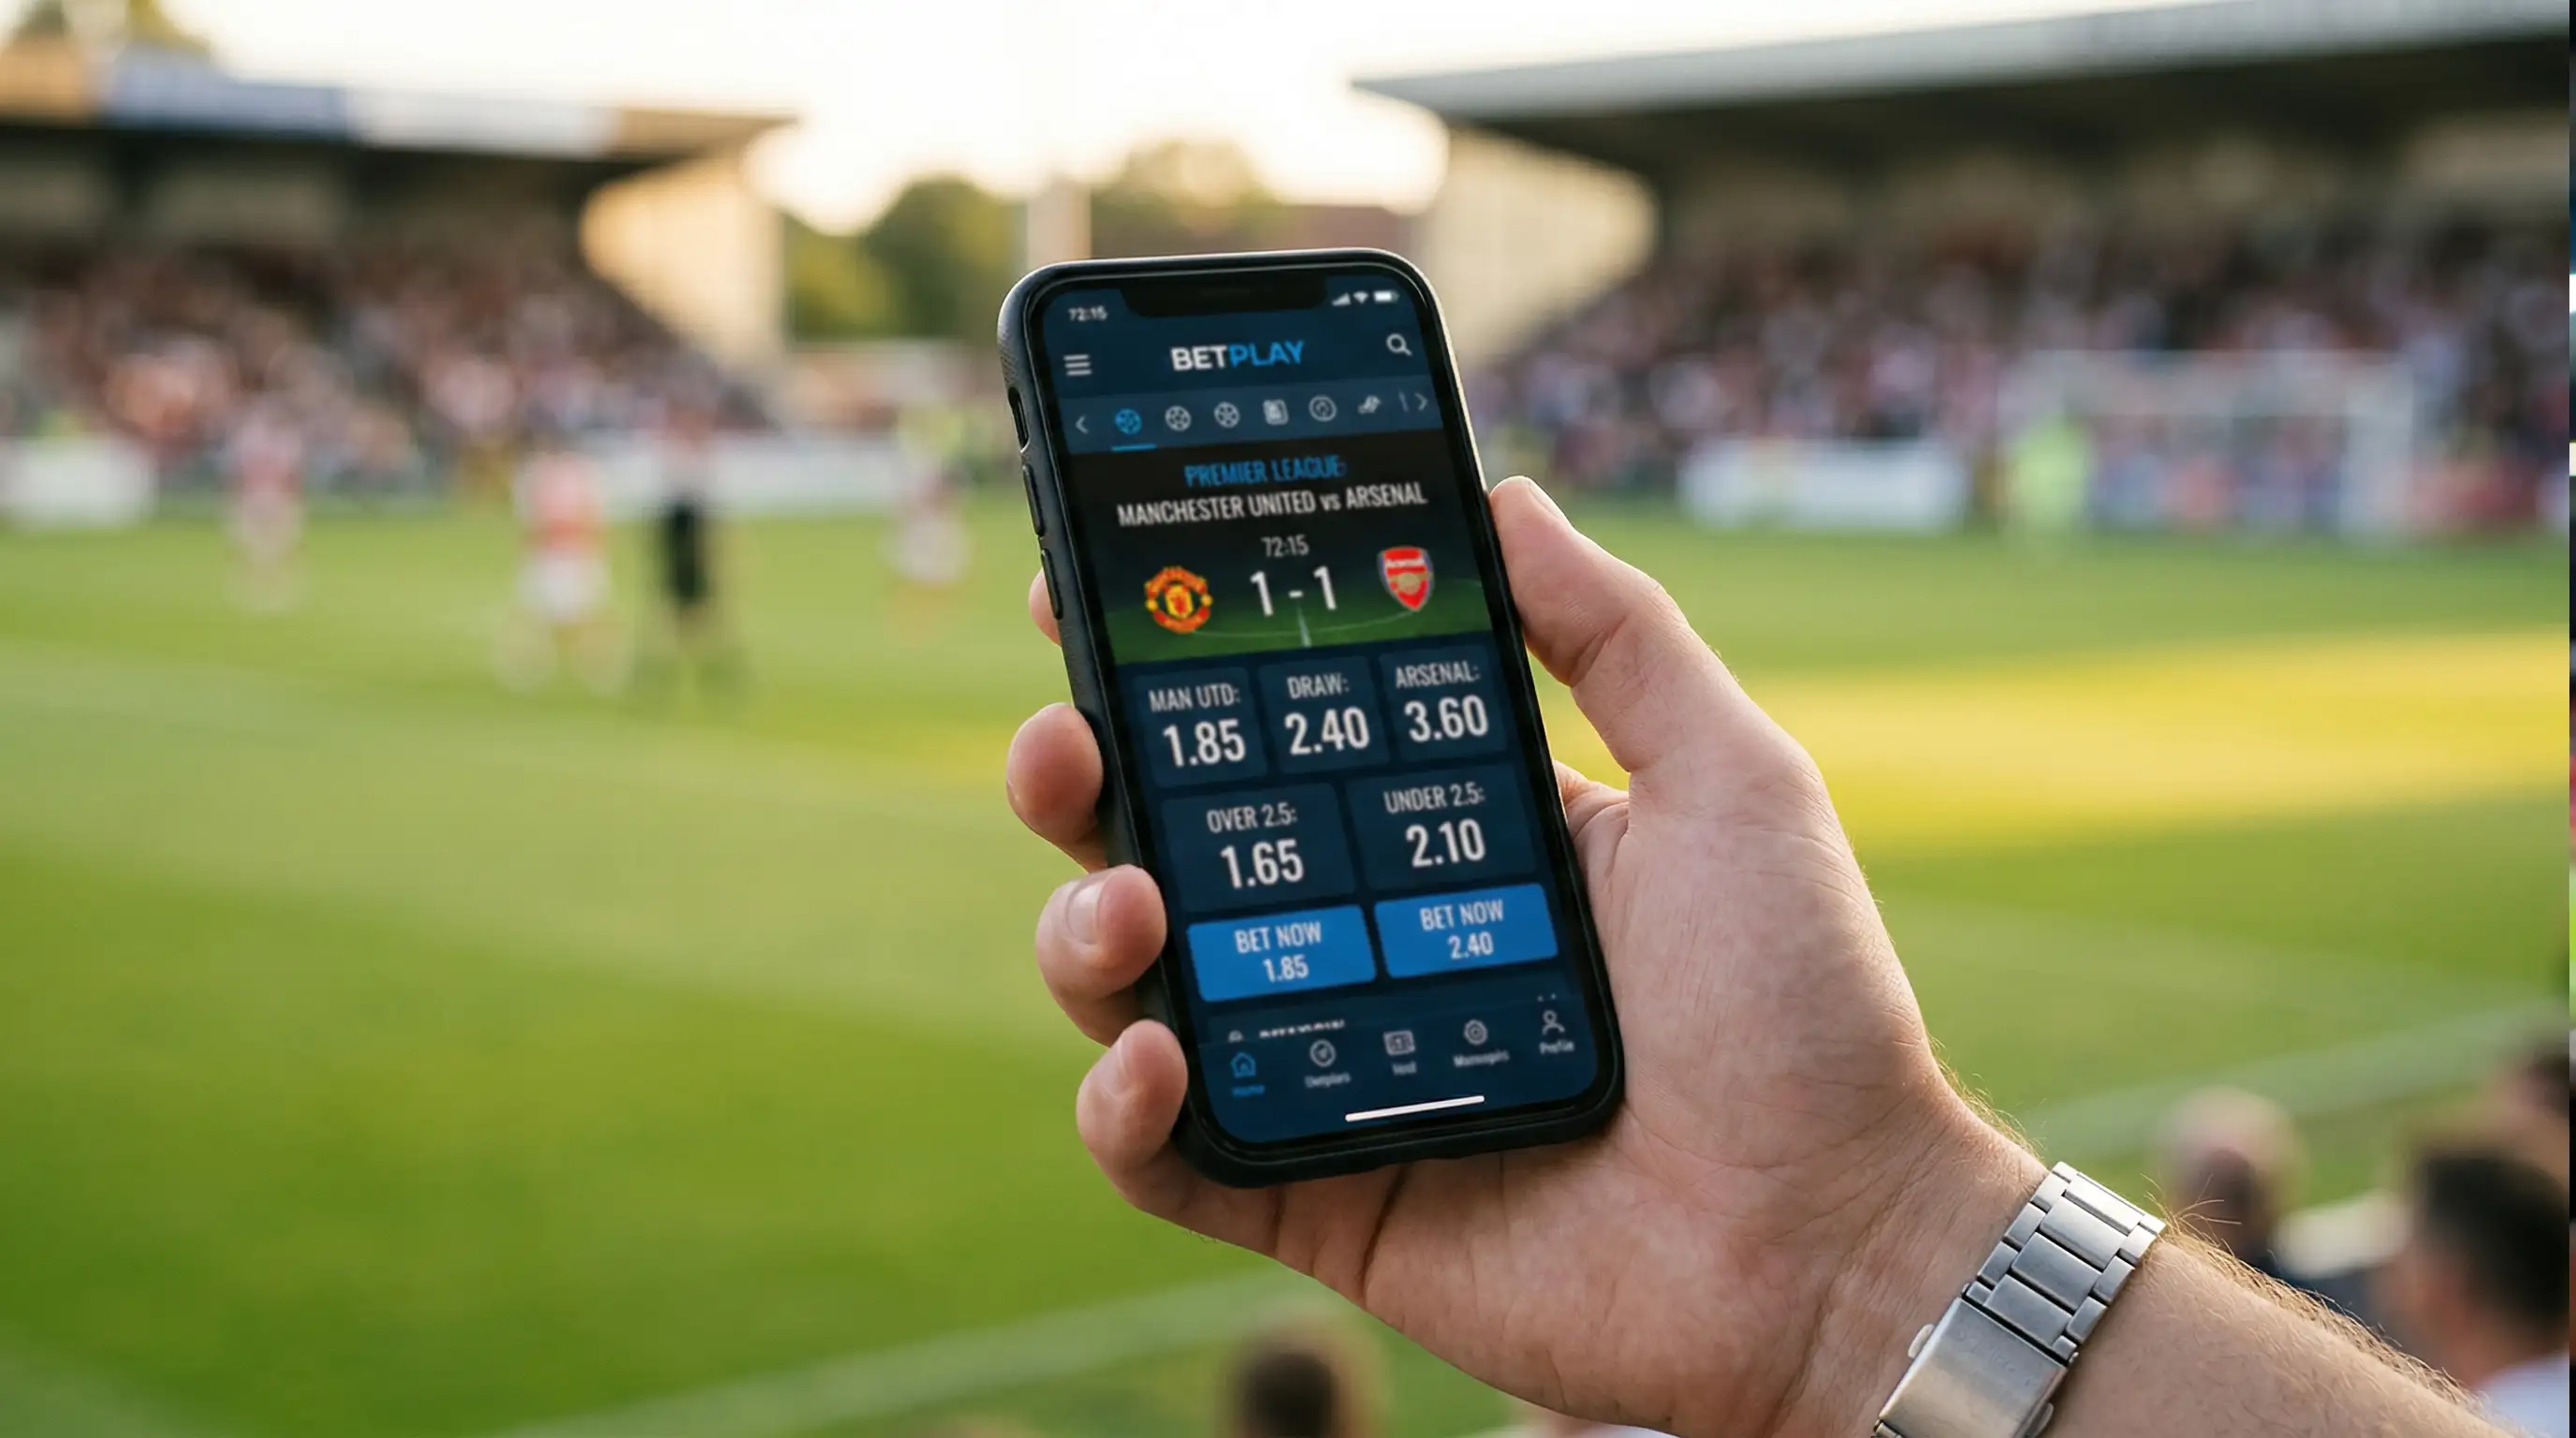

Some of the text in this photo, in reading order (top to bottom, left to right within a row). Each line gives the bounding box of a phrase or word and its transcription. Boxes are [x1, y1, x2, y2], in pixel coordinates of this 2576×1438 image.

[1069, 306, 1107, 322] 72:15
[1171, 340, 1304, 372] BETPLAY
[1184, 459, 1267, 488] PREMIER
[1117, 482, 1428, 527] MANCHESTER UNITED vs ARSENAL
[1261, 535, 1310, 558] 72:15
[1251, 571, 1273, 617] 1
[1313, 565, 1337, 610] 1
[1286, 673, 1350, 700] DRAW:
[1395, 660, 1482, 690] ARSENAL:
[1149, 683, 1241, 713] MAN UTD:
[1284, 706, 1370, 756] 2.40
[1404, 694, 1489, 743] 3.60
[1163, 718, 1247, 769] 1.85
[1383, 781, 1486, 814] UNDER 2.5:
[1207, 802, 1297, 834] OVER 2.5:
[1406, 818, 1487, 869] 2.10
[1221, 839, 1304, 890] 1.65
[1419, 899, 1505, 932] BET NOW
[1234, 921, 1323, 955] BET NOW
[1448, 931, 1494, 961] 2.40
[1263, 954, 1310, 984] 1.85
